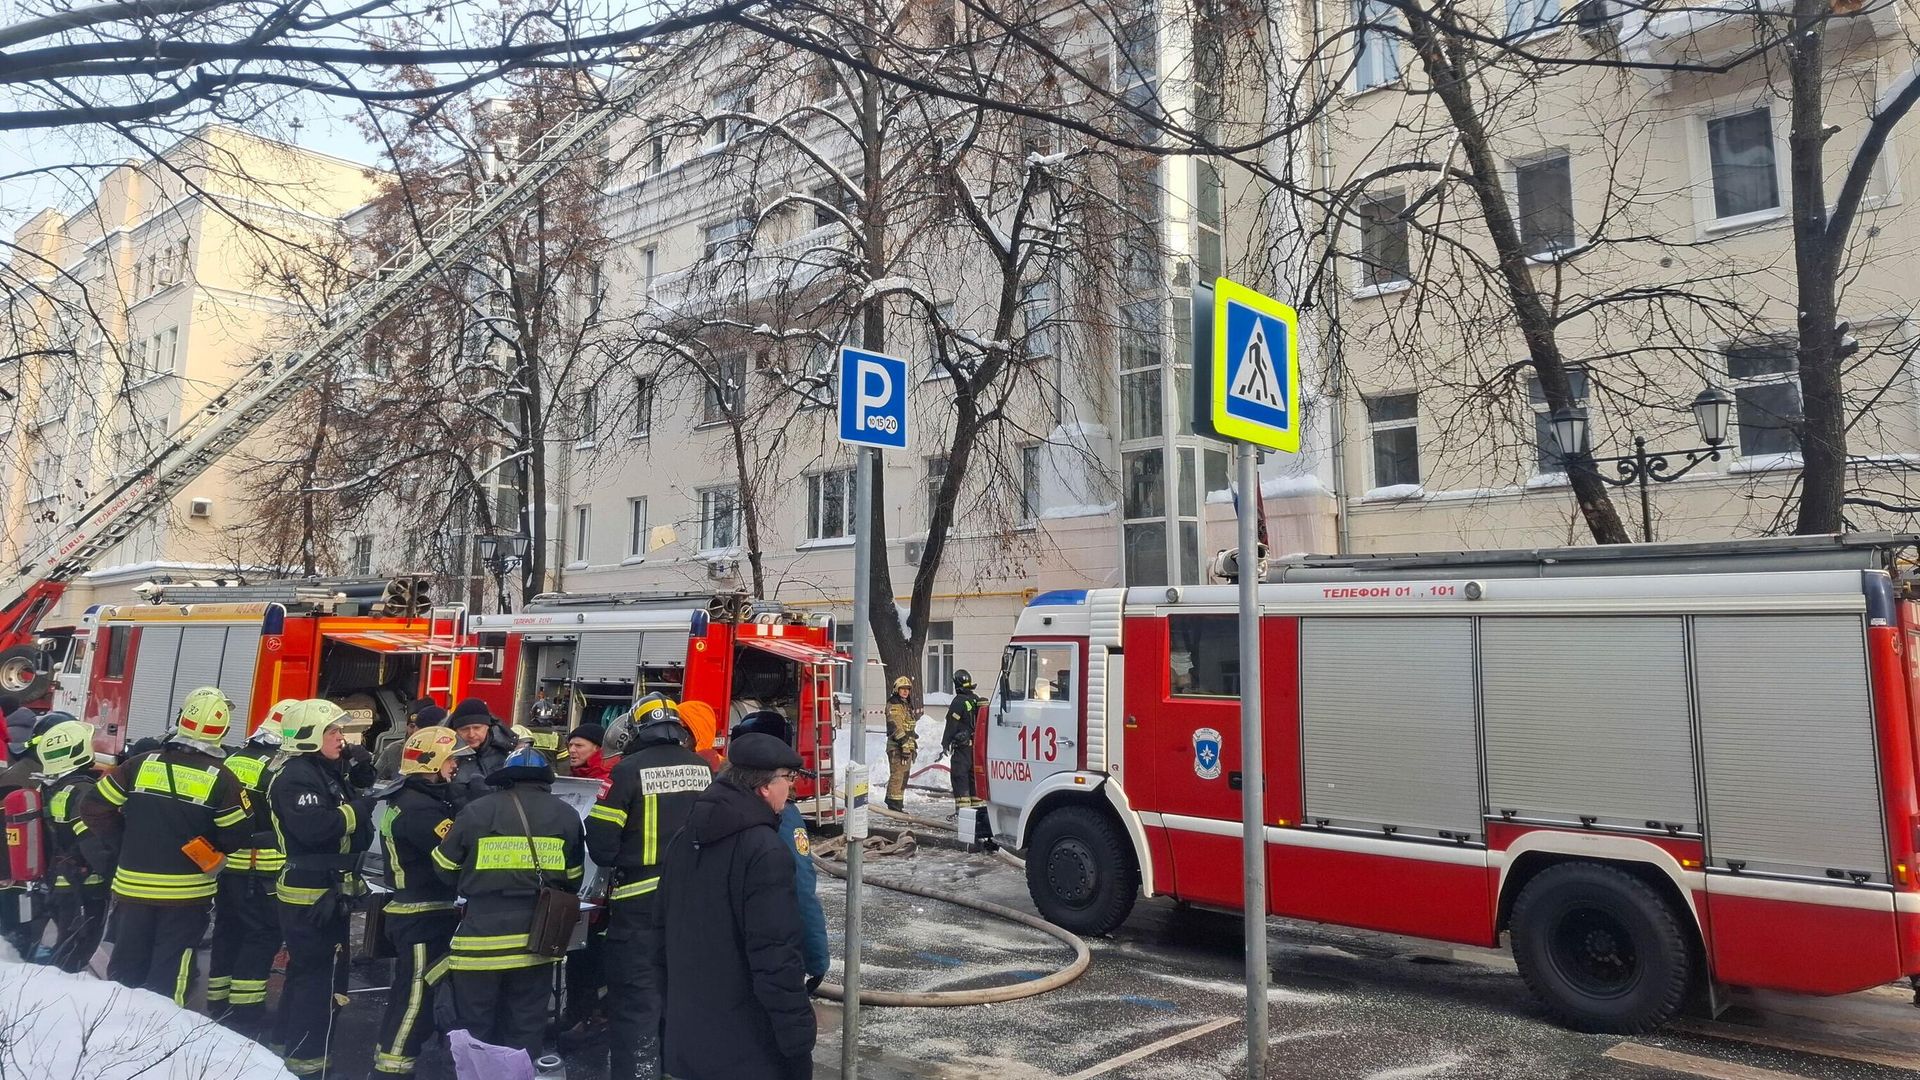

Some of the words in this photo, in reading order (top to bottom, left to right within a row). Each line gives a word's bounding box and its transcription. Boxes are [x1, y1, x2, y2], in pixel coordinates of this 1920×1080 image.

[856, 359, 892, 431] P
[877, 418, 884, 427] 15
[886, 419, 897, 430] 20
[1323, 588, 1390, 598] ТЕЛЕФОН
[1395, 587, 1410, 596] 01
[1430, 586, 1456, 596] 101
[46, 734, 68, 747] 271
[1018, 725, 1057, 761] 113
[644, 769, 684, 781] ПОЖАРНАЯ
[991, 760, 1032, 782] МОСКВА
[646, 781, 670, 791] МЧС
[672, 780, 710, 789] РОССИИ
[298, 793, 319, 806] 411
[483, 841, 530, 851] ПОЖАРНАЯ
[520, 854, 562, 864] РОСИИ
